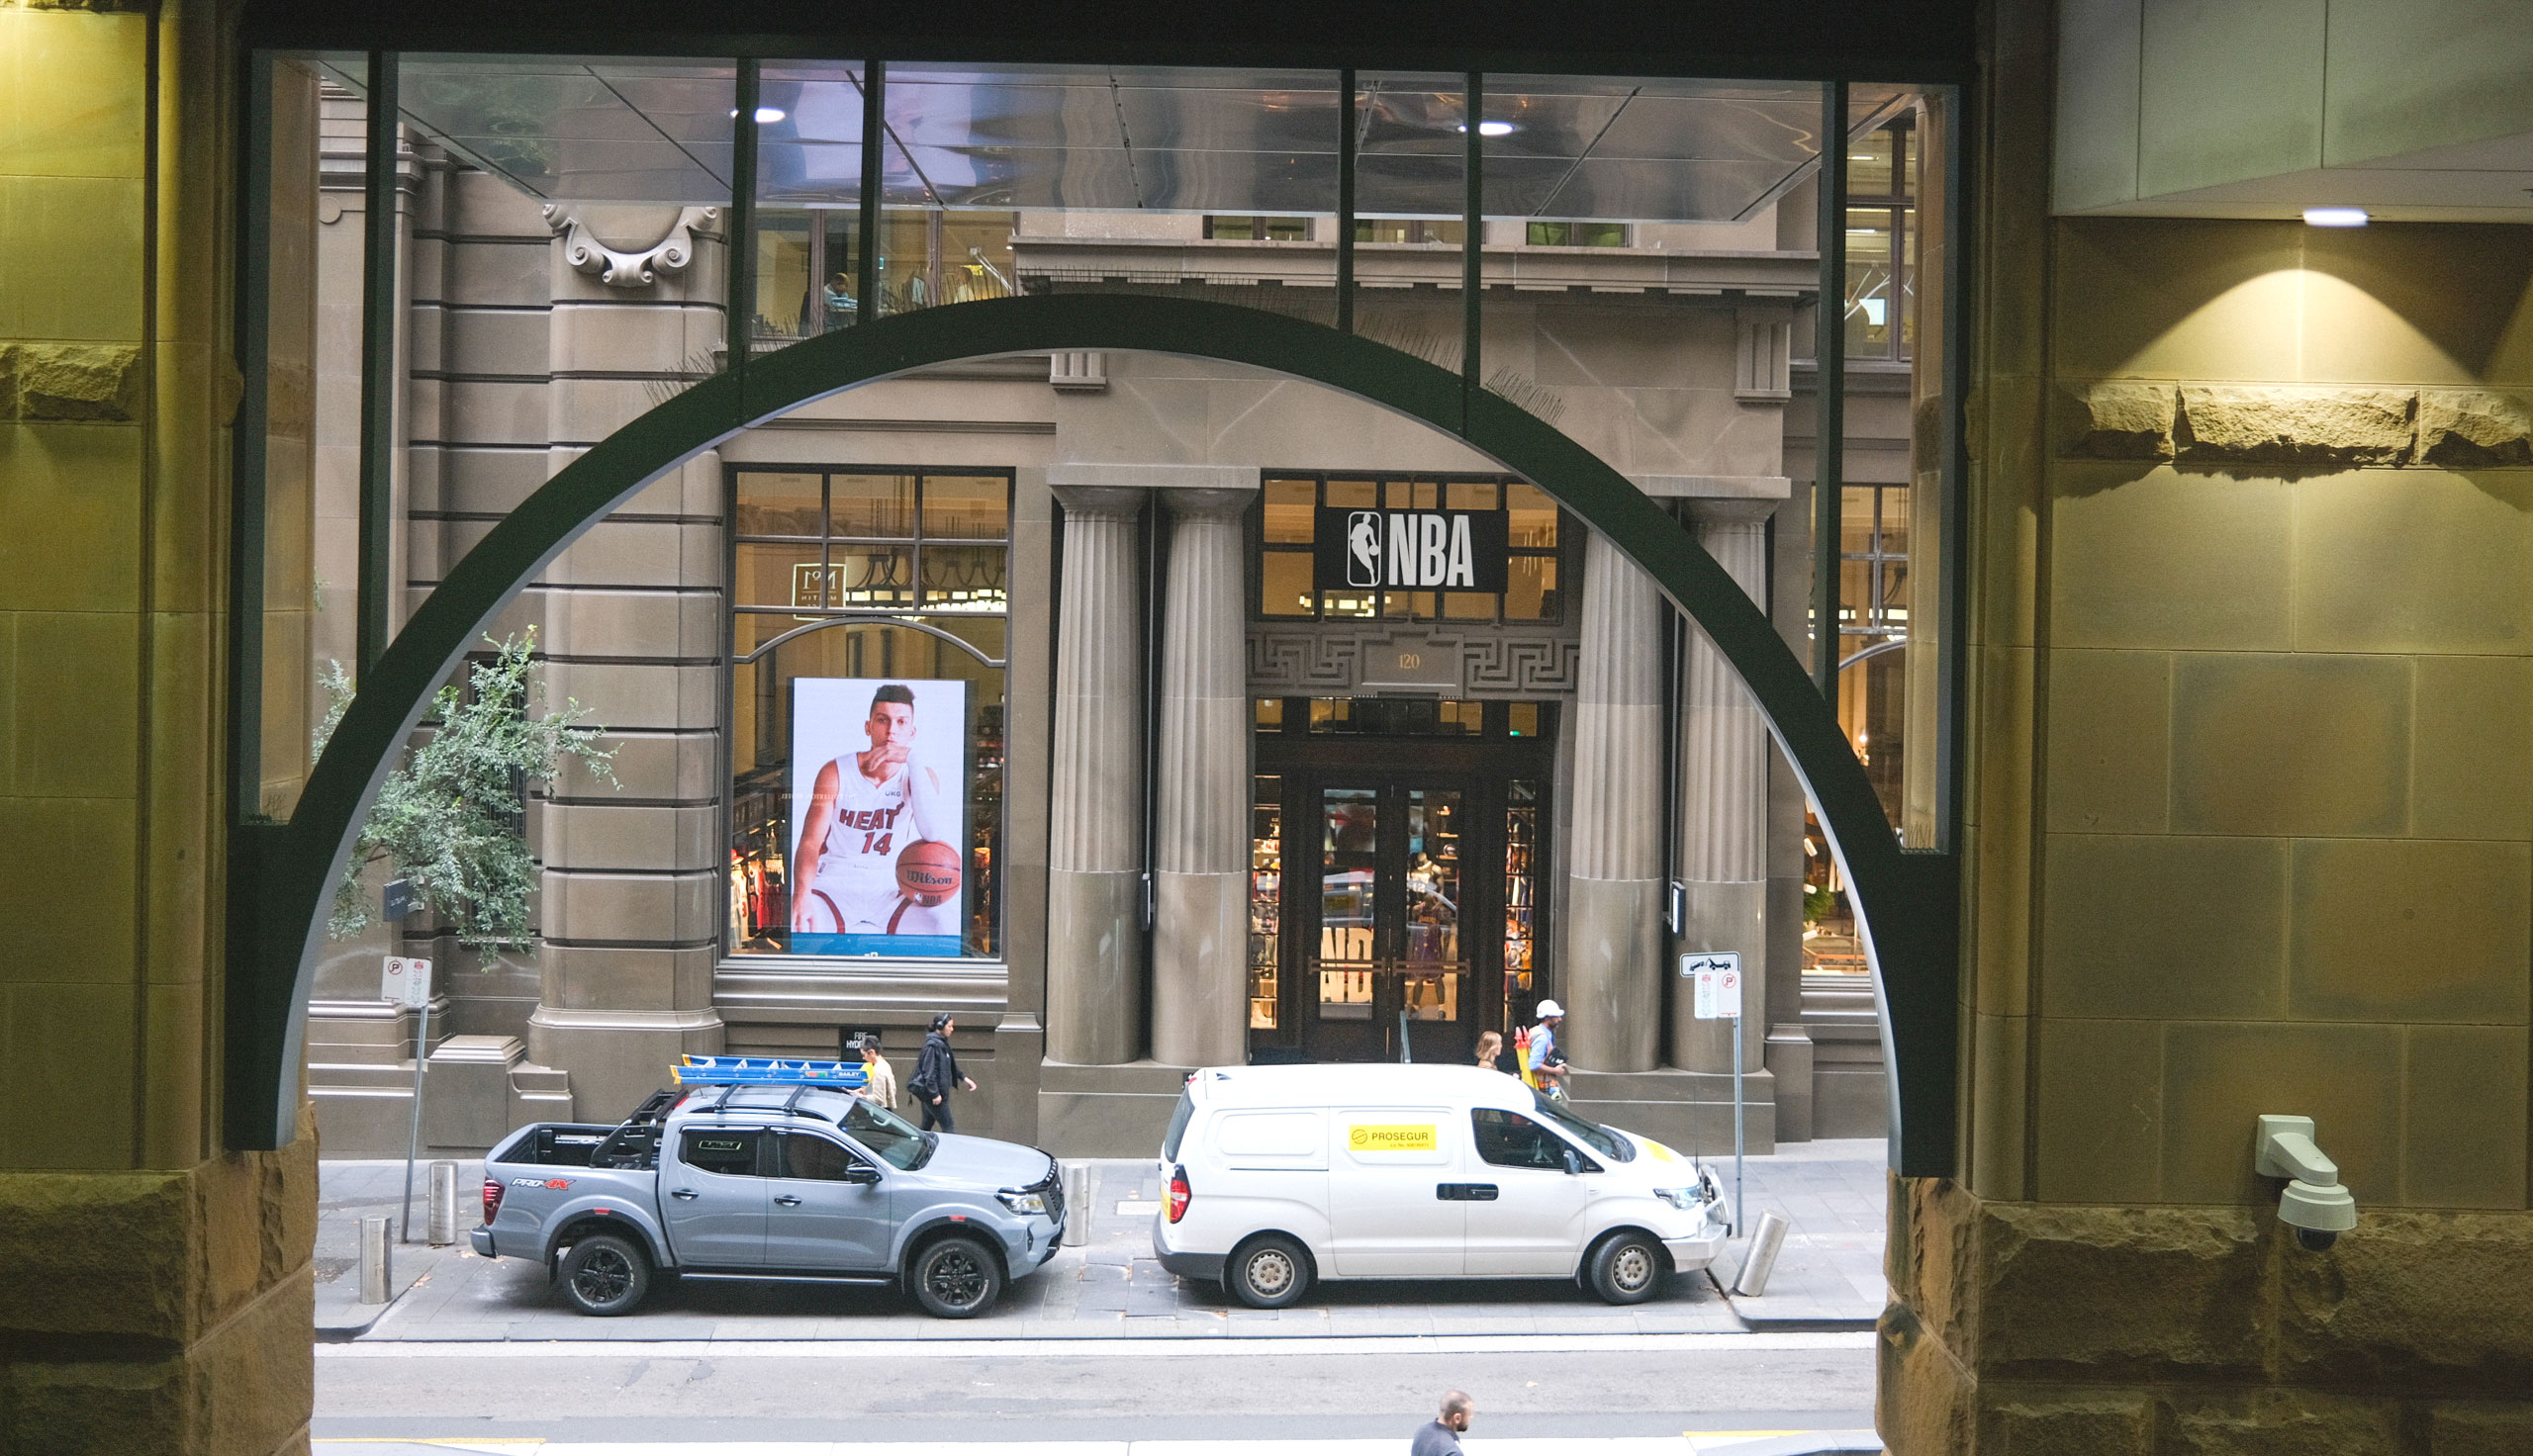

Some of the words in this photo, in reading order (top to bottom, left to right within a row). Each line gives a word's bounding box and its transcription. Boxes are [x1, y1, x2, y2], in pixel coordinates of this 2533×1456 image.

[1388, 513, 1474, 587] NBA
[1399, 654, 1421, 670] 120
[839, 801, 905, 831] HEAT
[861, 832, 892, 856] 14
[906, 869, 954, 885] Wilson
[1371, 1132, 1429, 1140] PROSEGUR
